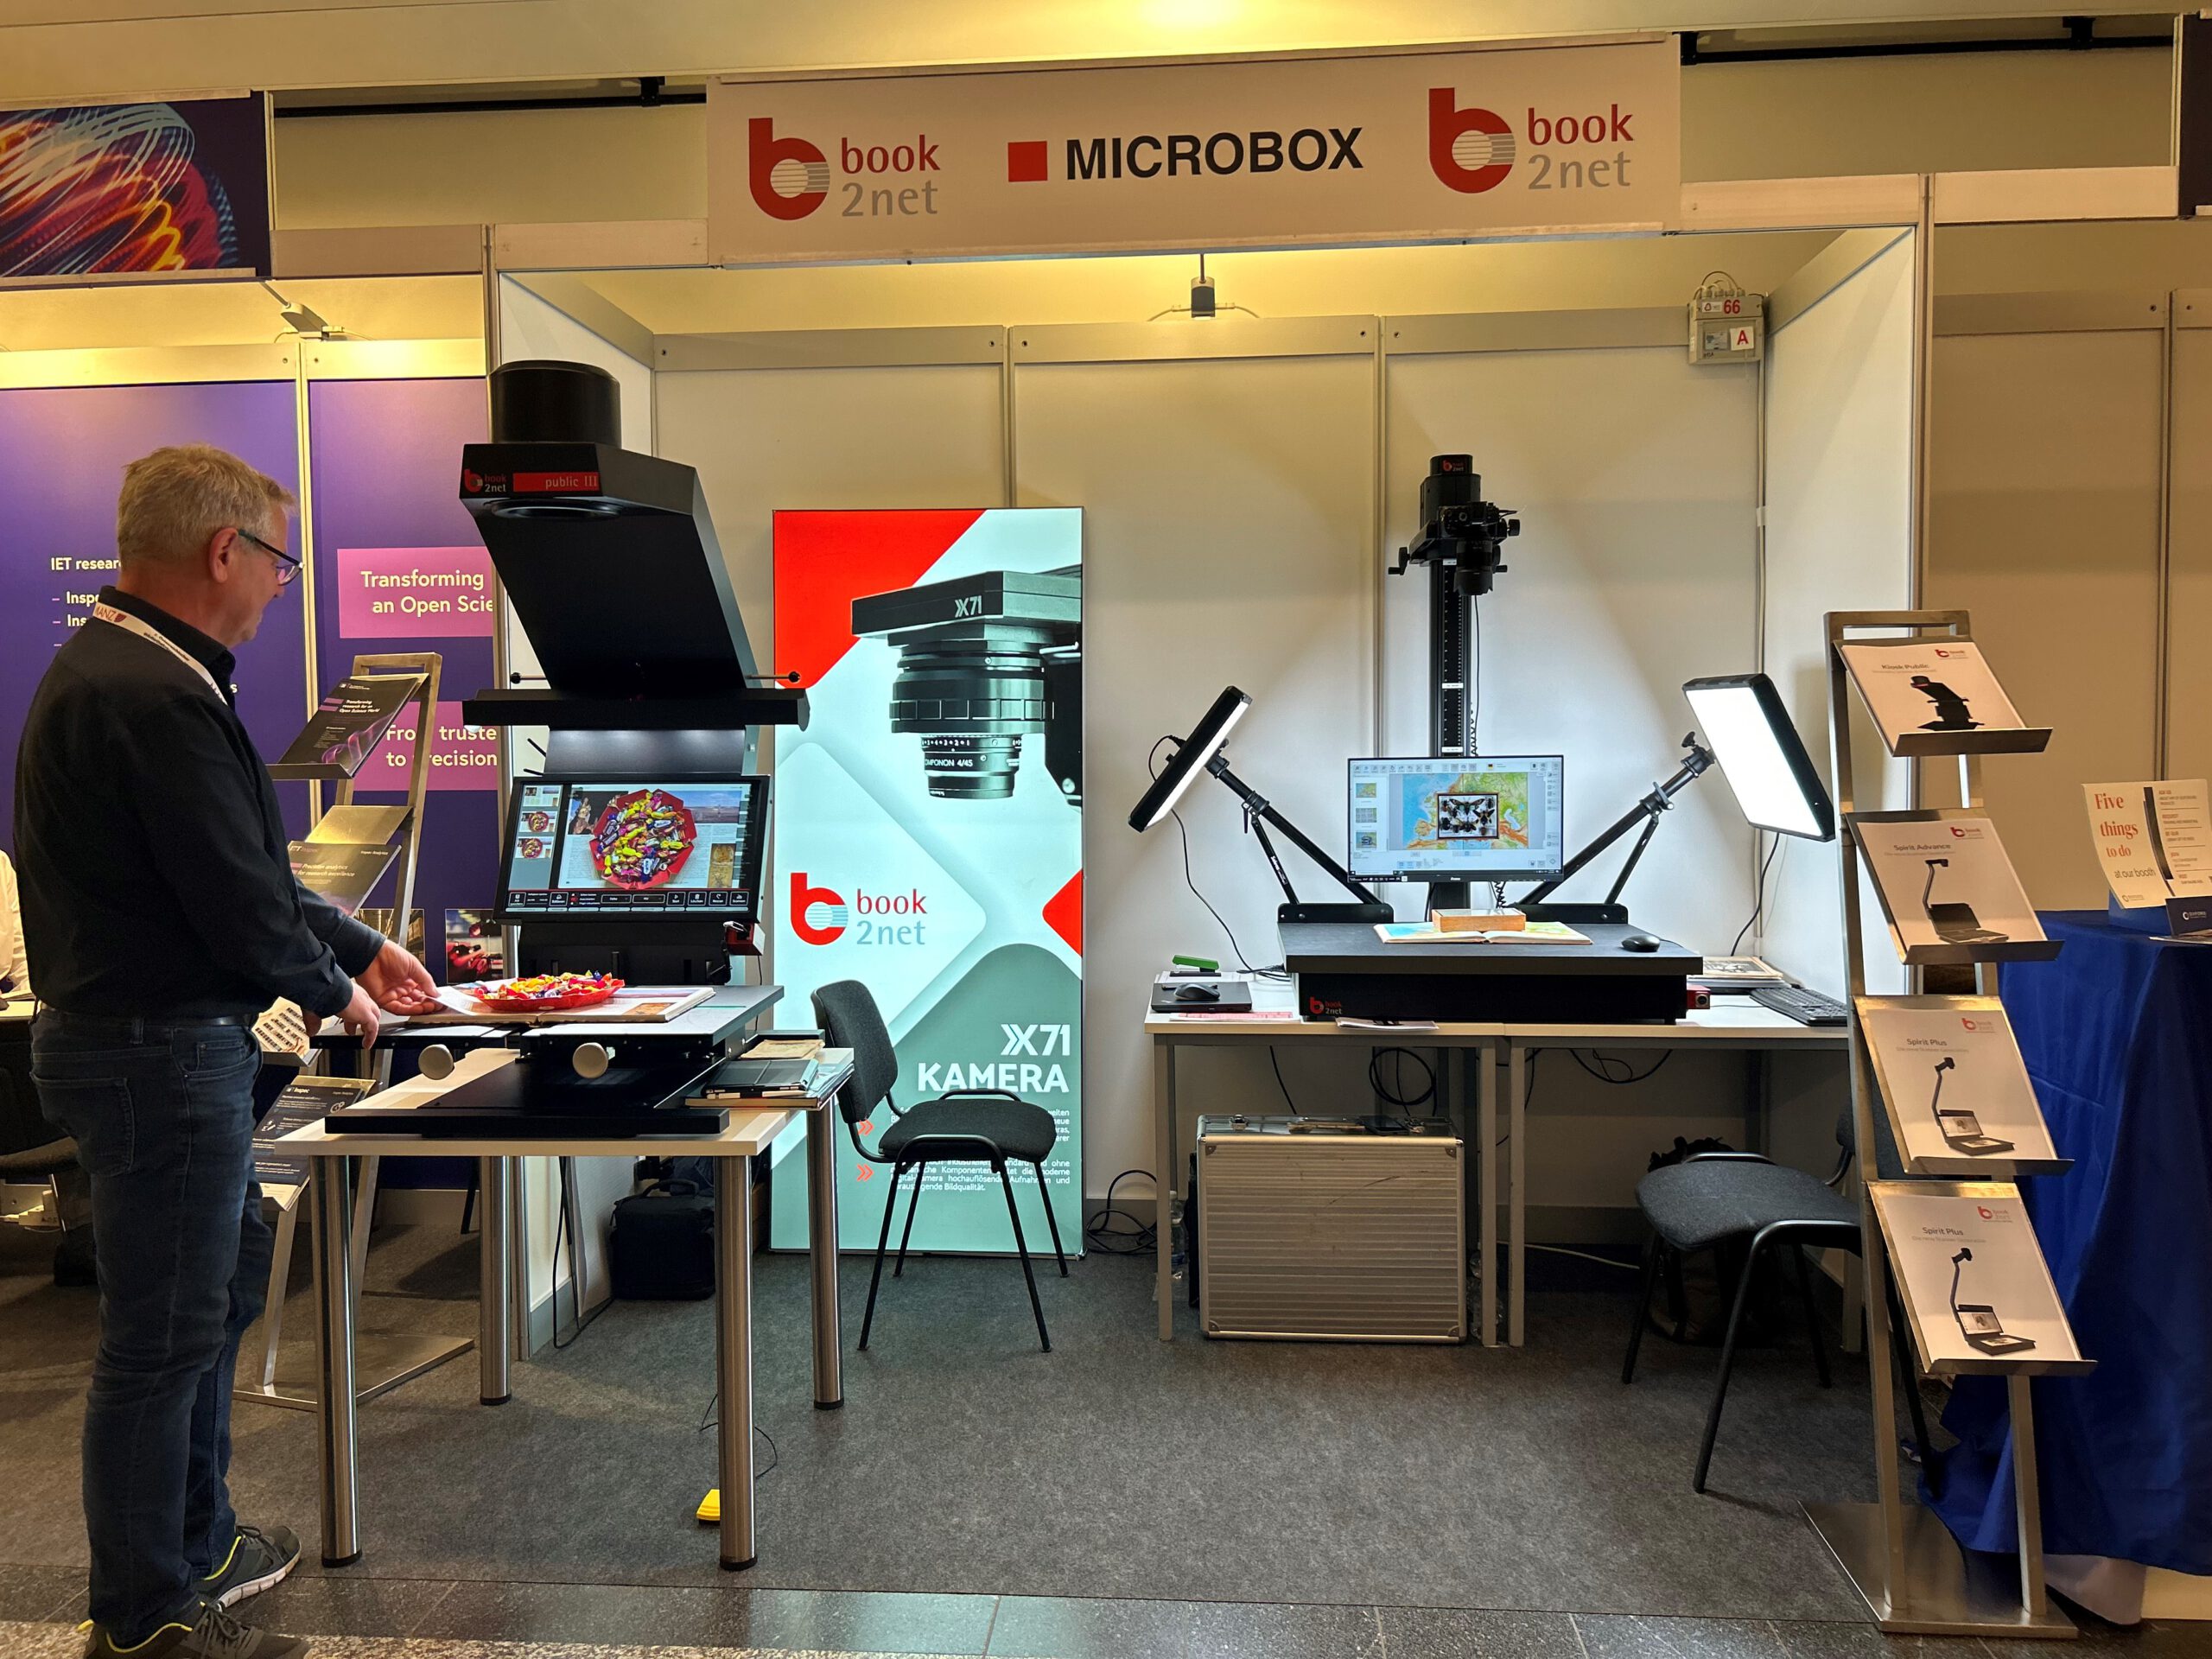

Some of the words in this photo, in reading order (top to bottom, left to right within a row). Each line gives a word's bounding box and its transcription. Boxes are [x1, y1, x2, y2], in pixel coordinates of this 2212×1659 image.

[1527, 104, 1634, 146] book
[842, 135, 941, 174] book
[1066, 127, 1363, 180] MICROBOX
[1528, 151, 1631, 189] 2net
[842, 180, 938, 217] 2net
[1723, 299, 1740, 314] 66
[1737, 329, 1749, 345] A
[485, 483, 506, 493] 2net
[545, 478, 579, 490] public
[51, 557, 73, 570] IET
[360, 569, 484, 591] Transforming
[372, 601, 395, 613] an
[400, 595, 451, 618] Open
[386, 725, 416, 741] Fro
[385, 752, 407, 767] to
[412, 749, 498, 766] ecision
[957, 759, 974, 767] 4/45
[2094, 792, 2124, 810] Five
[2100, 821, 2139, 840] things
[2106, 846, 2117, 857] to
[2119, 844, 2132, 857] do
[2122, 869, 2134, 878] our
[2134, 867, 2156, 878] booth
[856, 888, 927, 914] book
[856, 920, 926, 944] 2net
[1906, 1038, 1929, 1046] Spirit
[918, 1062, 1070, 1093] KAMERA
[942, 1166, 992, 1174] Komponenten
[944, 1182, 986, 1192] Bildqualität.
[1922, 1227, 1946, 1236] Spirit
